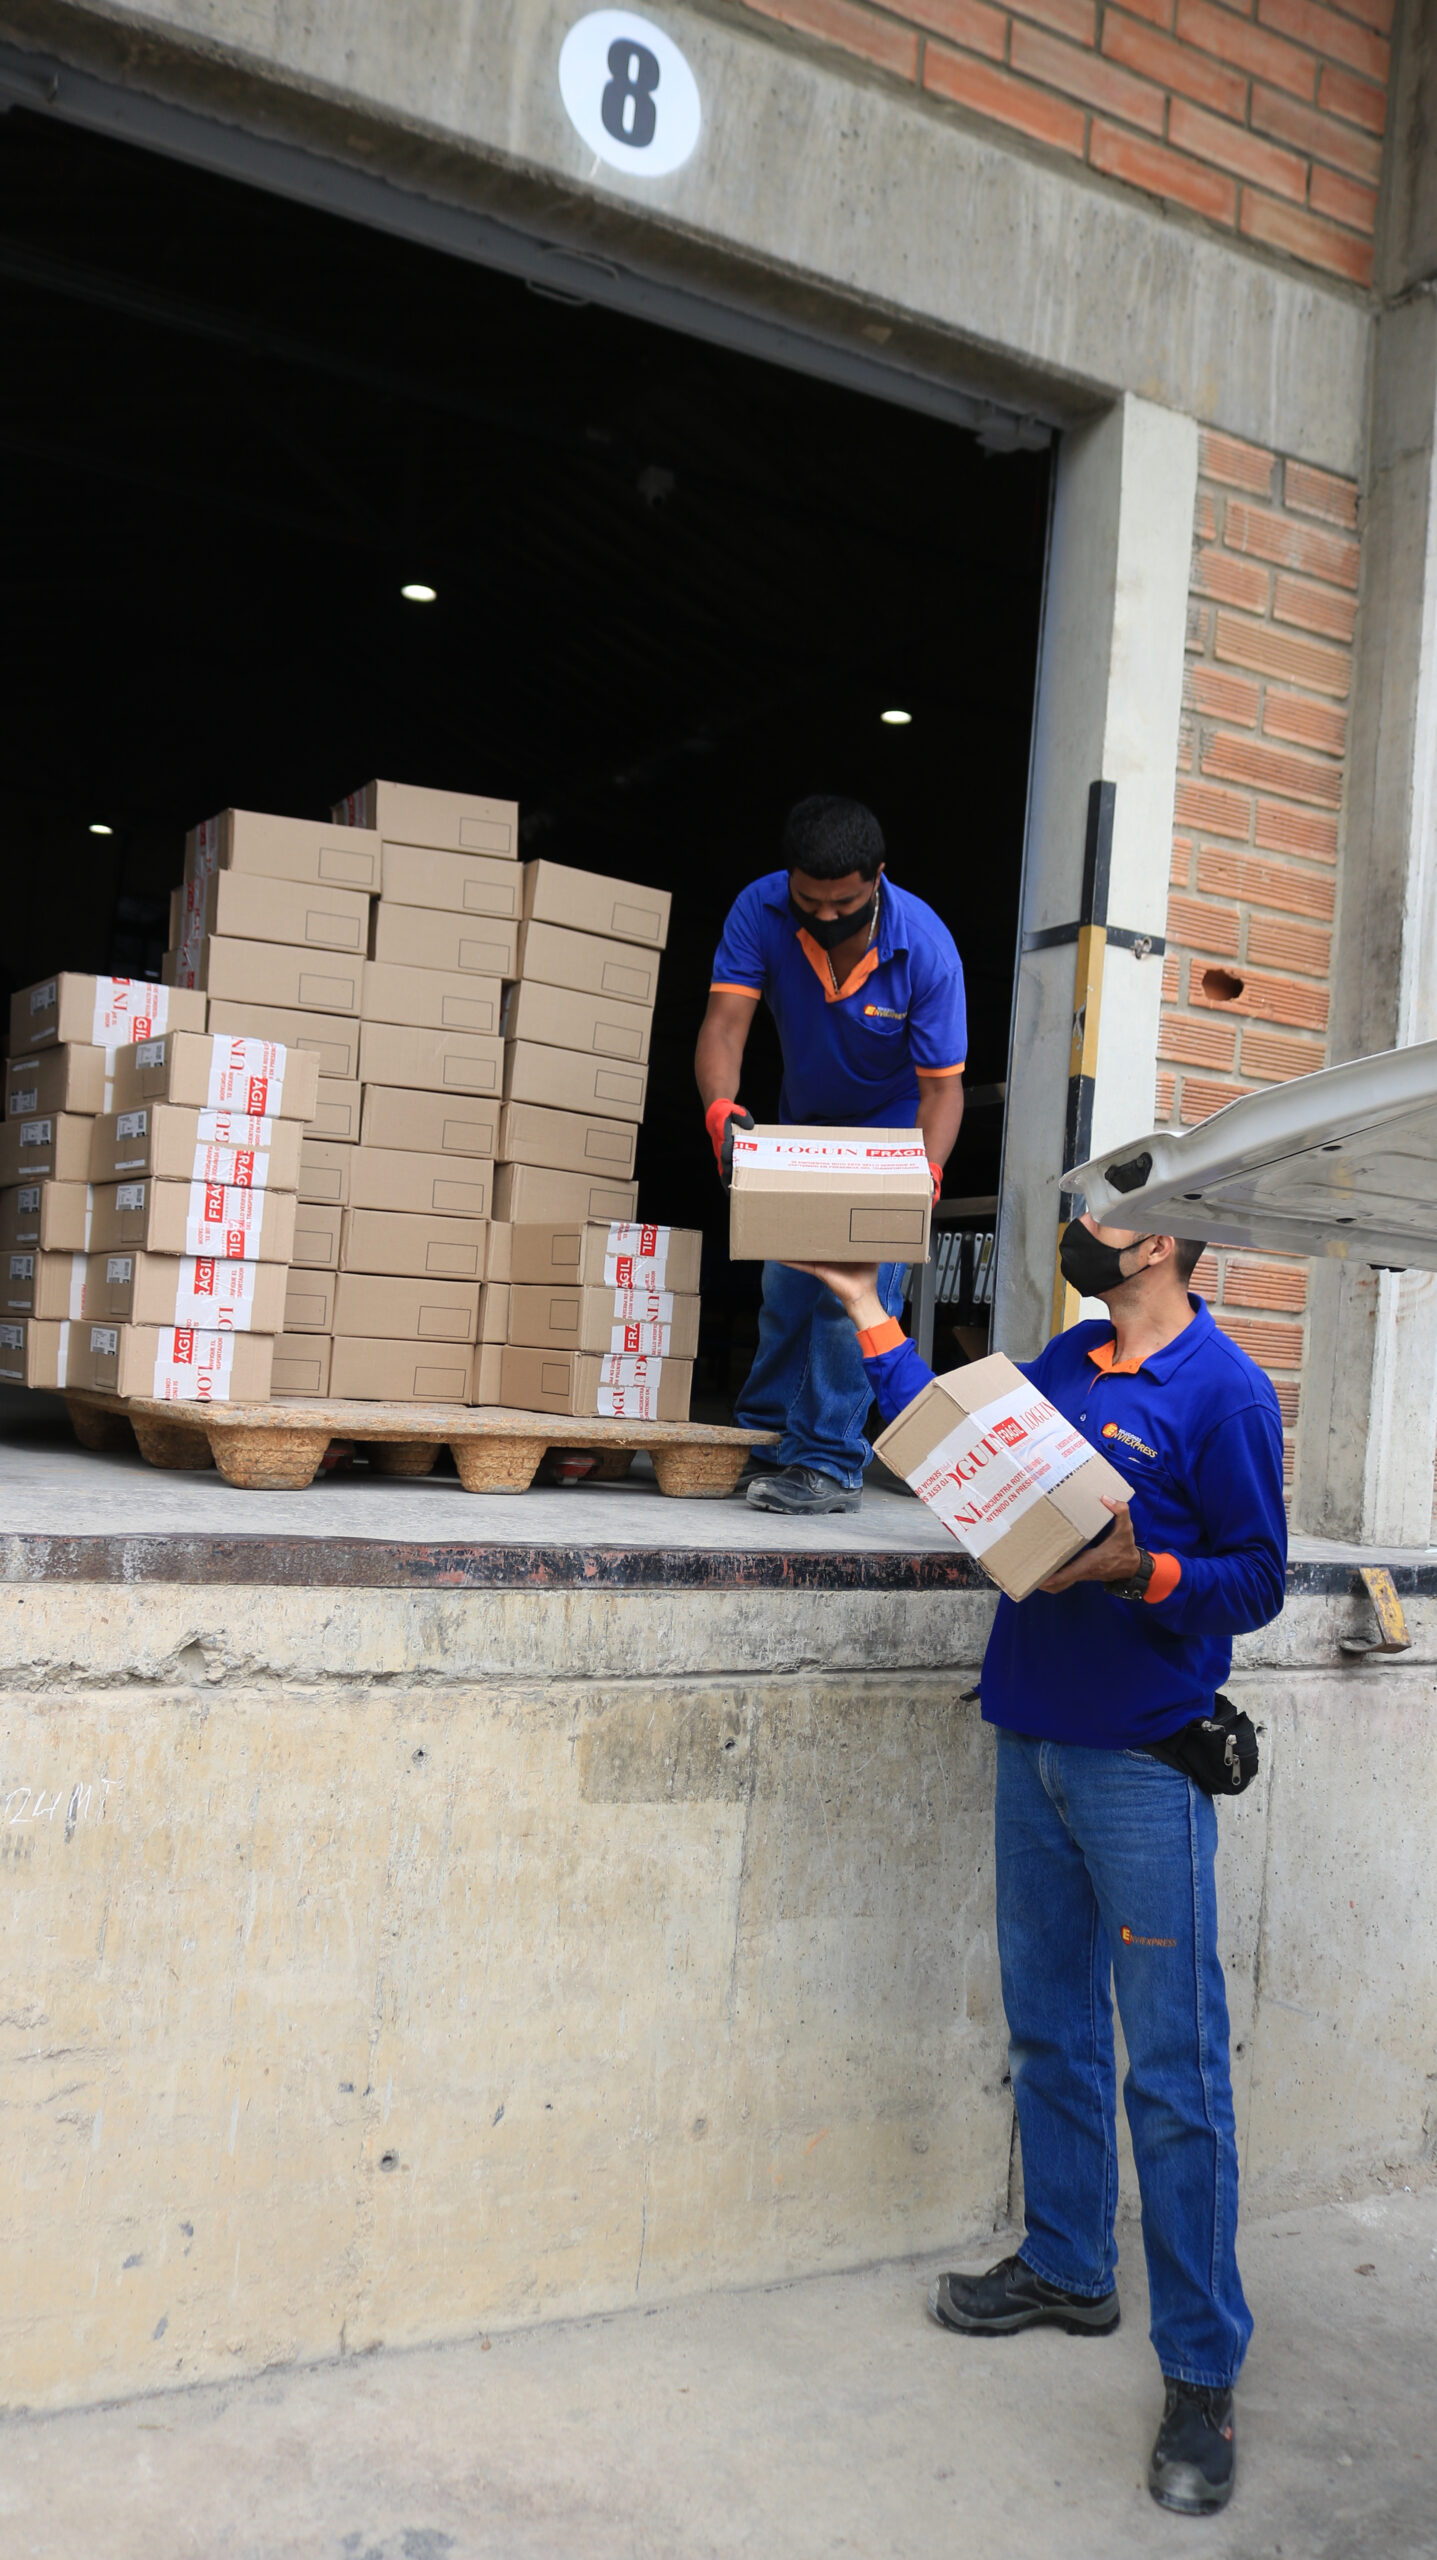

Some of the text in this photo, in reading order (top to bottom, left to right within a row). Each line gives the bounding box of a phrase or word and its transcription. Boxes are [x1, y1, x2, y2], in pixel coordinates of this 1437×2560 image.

[602, 37, 660, 148] 8
[250, 1076, 267, 1114] ÁGIL
[776, 1145, 858, 1156] LOGUIN
[982, 1482, 1013, 1514] ENCUENTRA
